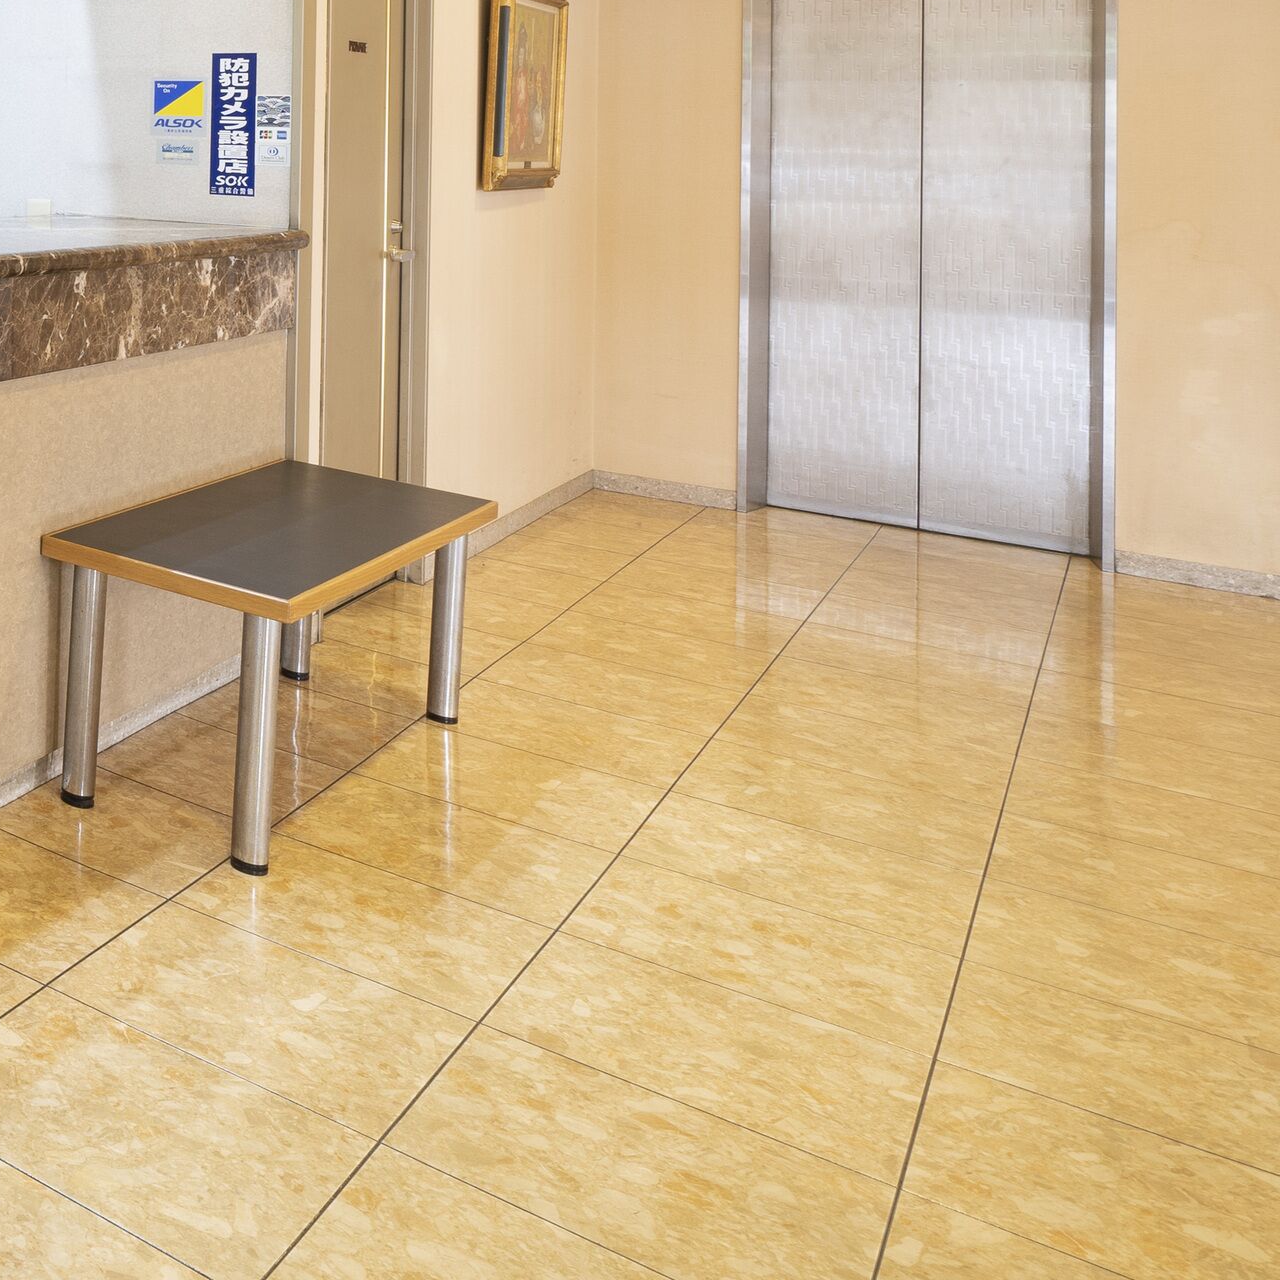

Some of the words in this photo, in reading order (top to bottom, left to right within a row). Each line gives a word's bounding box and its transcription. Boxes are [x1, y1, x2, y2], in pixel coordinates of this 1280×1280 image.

[216, 57, 250, 175] 防犯カメラ設置店
[154, 118, 203, 129] ALSOK
[215, 175, 249, 187] SOK
